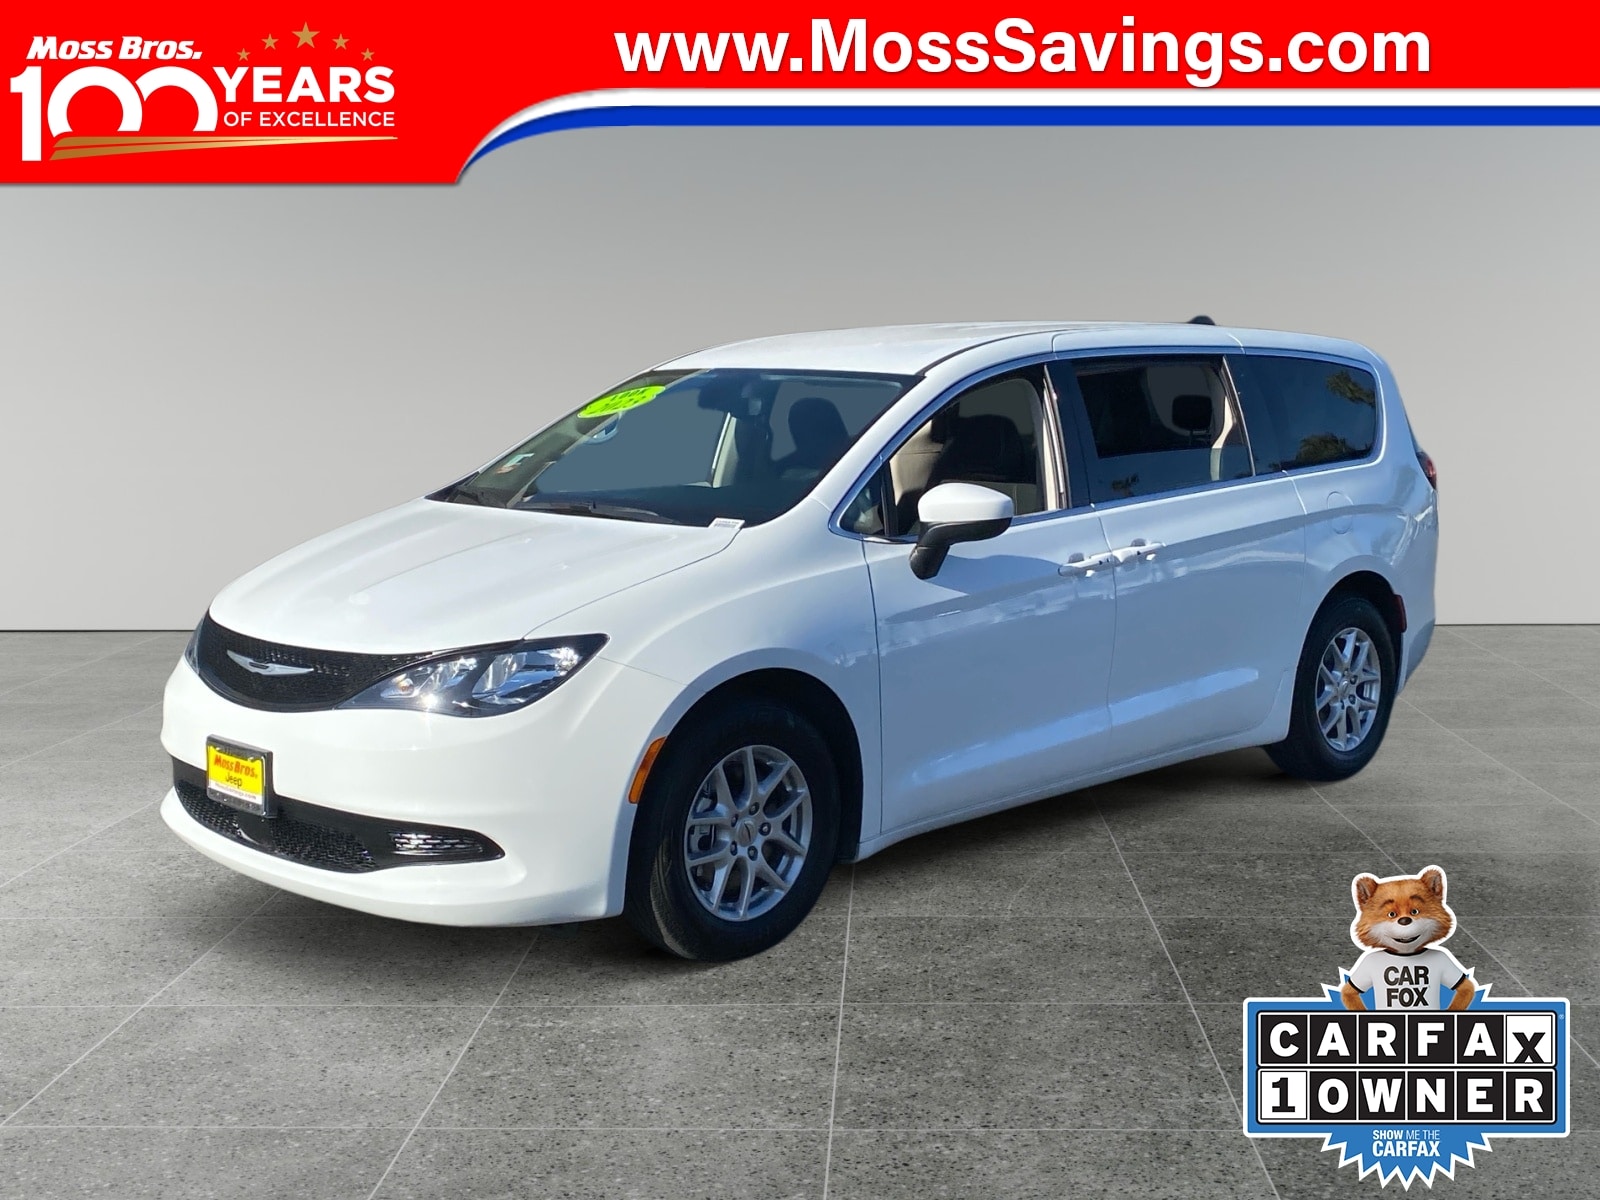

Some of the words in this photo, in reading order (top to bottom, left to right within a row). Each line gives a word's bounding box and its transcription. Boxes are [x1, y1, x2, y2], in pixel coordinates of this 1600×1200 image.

[214, 754, 234, 772] Moss
[234, 760, 258, 779] Bros.
[225, 772, 243, 788] Jeep
